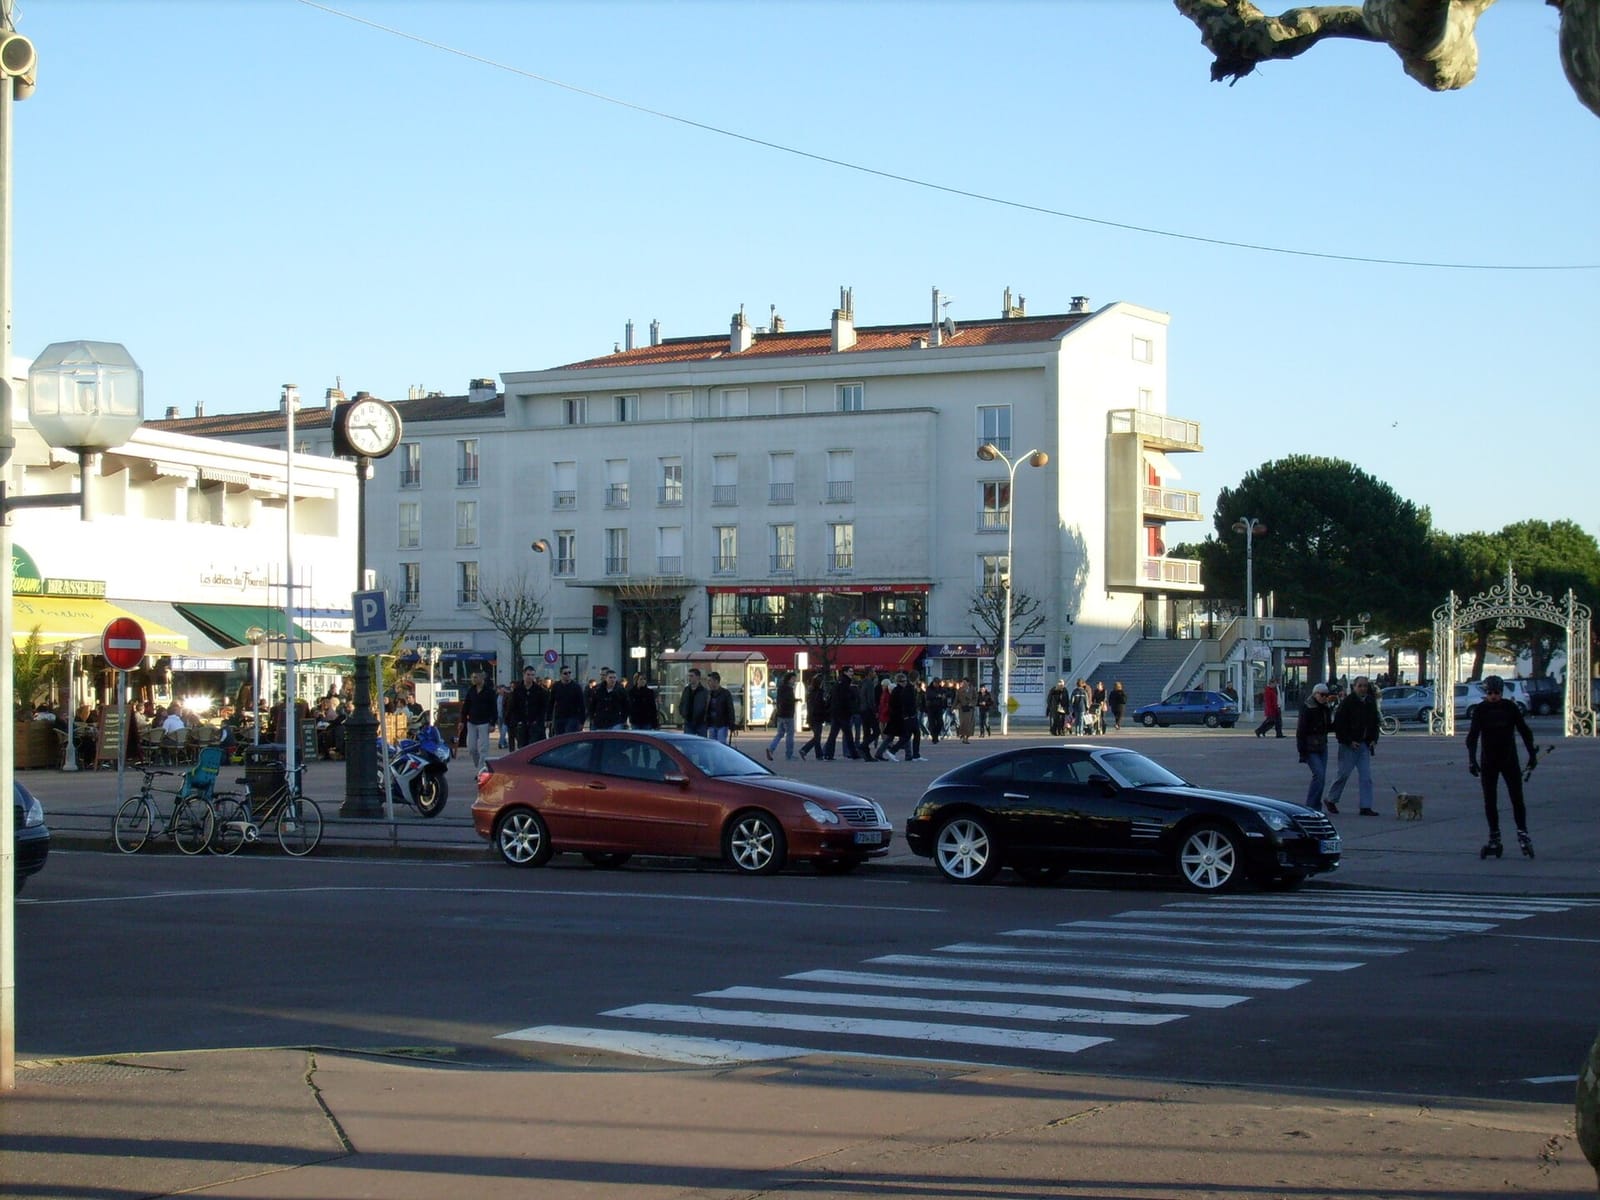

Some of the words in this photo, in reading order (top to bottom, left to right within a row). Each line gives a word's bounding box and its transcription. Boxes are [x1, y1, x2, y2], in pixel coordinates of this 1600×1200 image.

[48, 580, 105, 595] BRASSERIE
[362, 599, 378, 627] P
[305, 620, 342, 629] ALAIN
